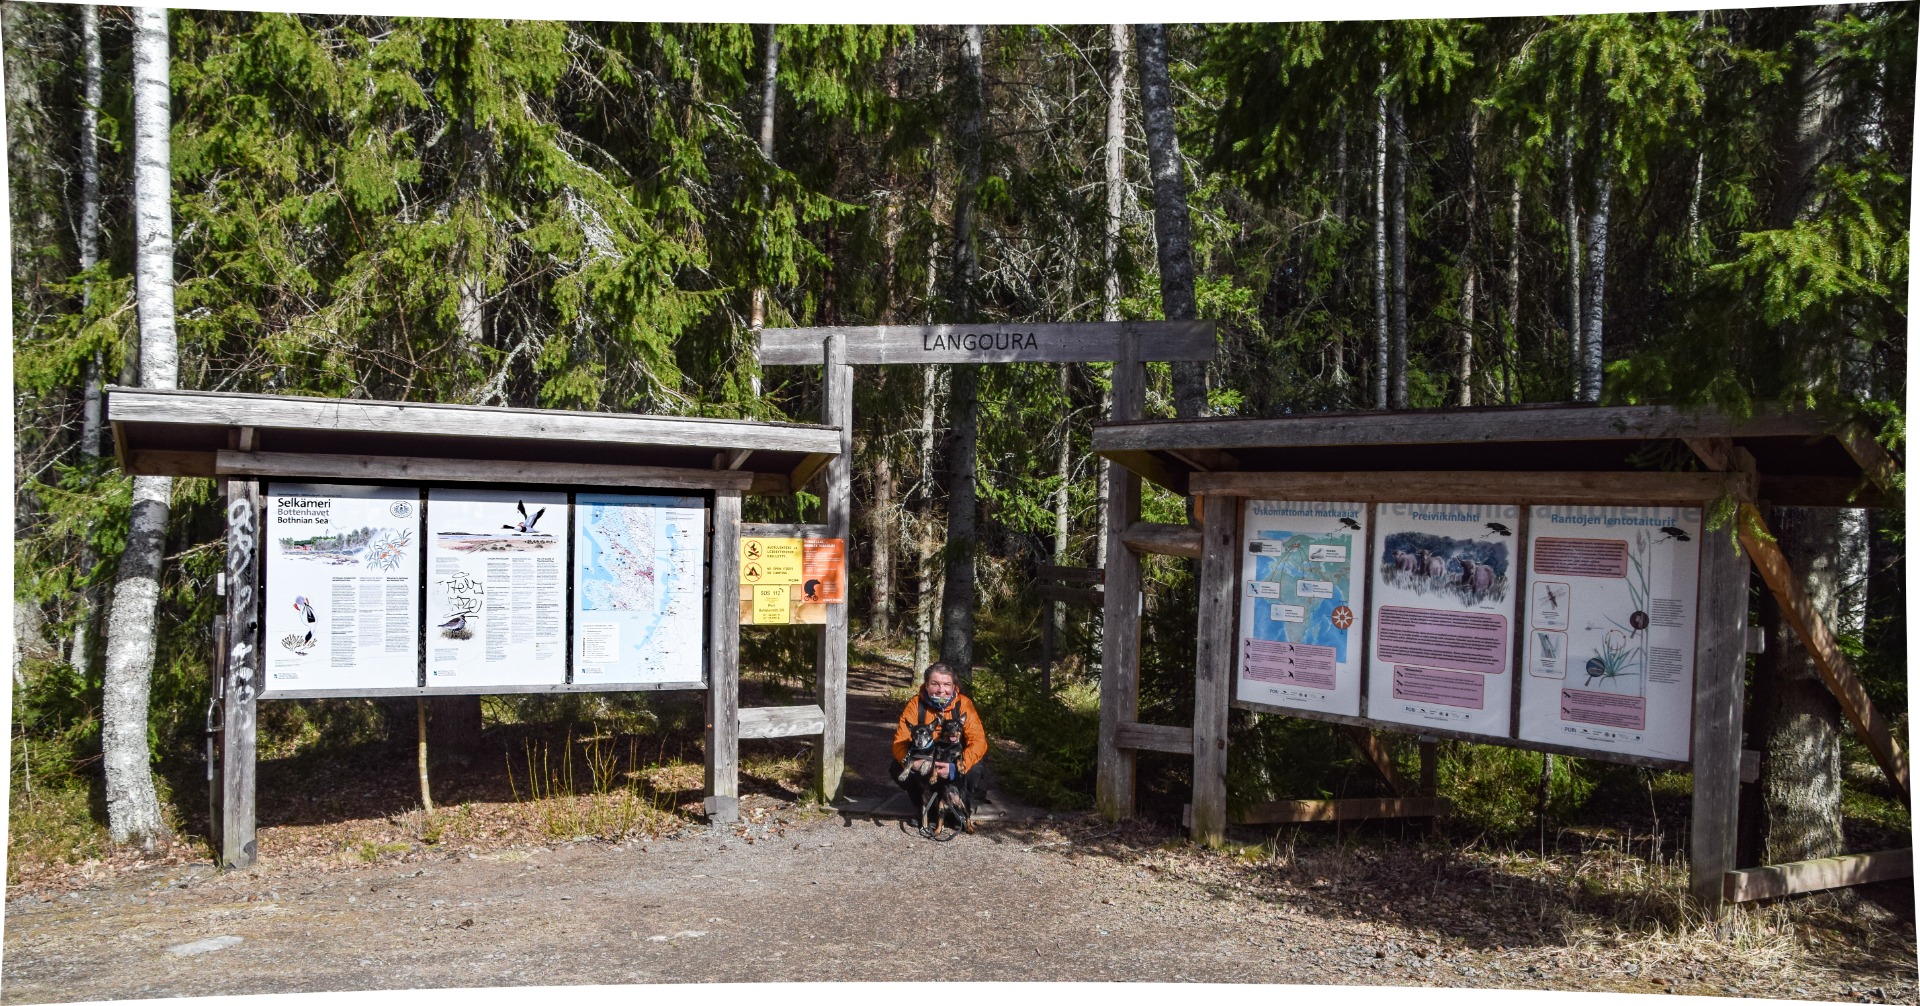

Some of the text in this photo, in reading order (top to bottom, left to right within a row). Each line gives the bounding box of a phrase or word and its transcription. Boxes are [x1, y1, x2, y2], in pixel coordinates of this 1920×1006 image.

[923, 332, 1038, 351] LANGOURA
[277, 497, 331, 508] Selkämeri
[277, 508, 330, 517] Bottenhavet
[1254, 507, 1359, 519] Uskomattomat matkaajat
[1412, 511, 1480, 522] Preiviikinlahti
[1551, 513, 1676, 527] Rantojen lentotaiturit
